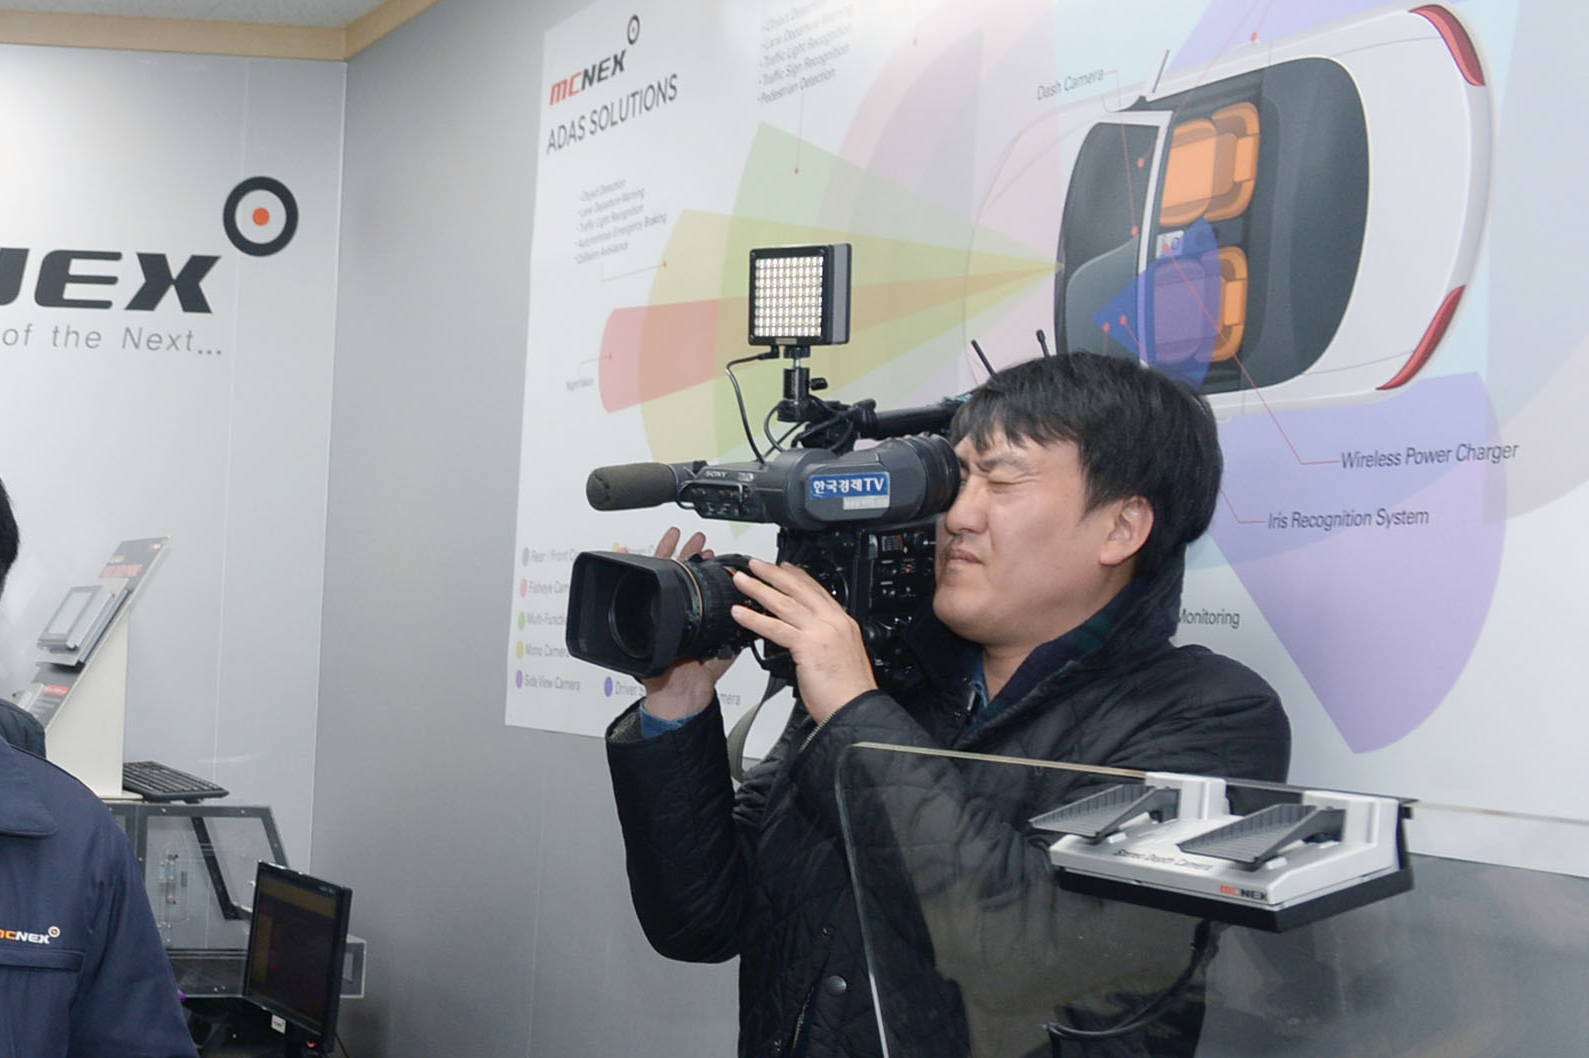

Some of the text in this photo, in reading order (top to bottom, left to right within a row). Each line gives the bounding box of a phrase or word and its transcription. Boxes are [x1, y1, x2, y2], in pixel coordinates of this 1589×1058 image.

[548, 49, 627, 106] MCNEX
[546, 73, 678, 155] ADAS SOLUTIONS
[1, 322, 35, 349] of
[51, 323, 102, 351] the
[121, 326, 223, 356] Next...
[1341, 442, 1520, 470] Wireless Power Charger
[813, 477, 884, 494] 한국경제TV
[1268, 508, 1430, 531] Iris Recognition System
